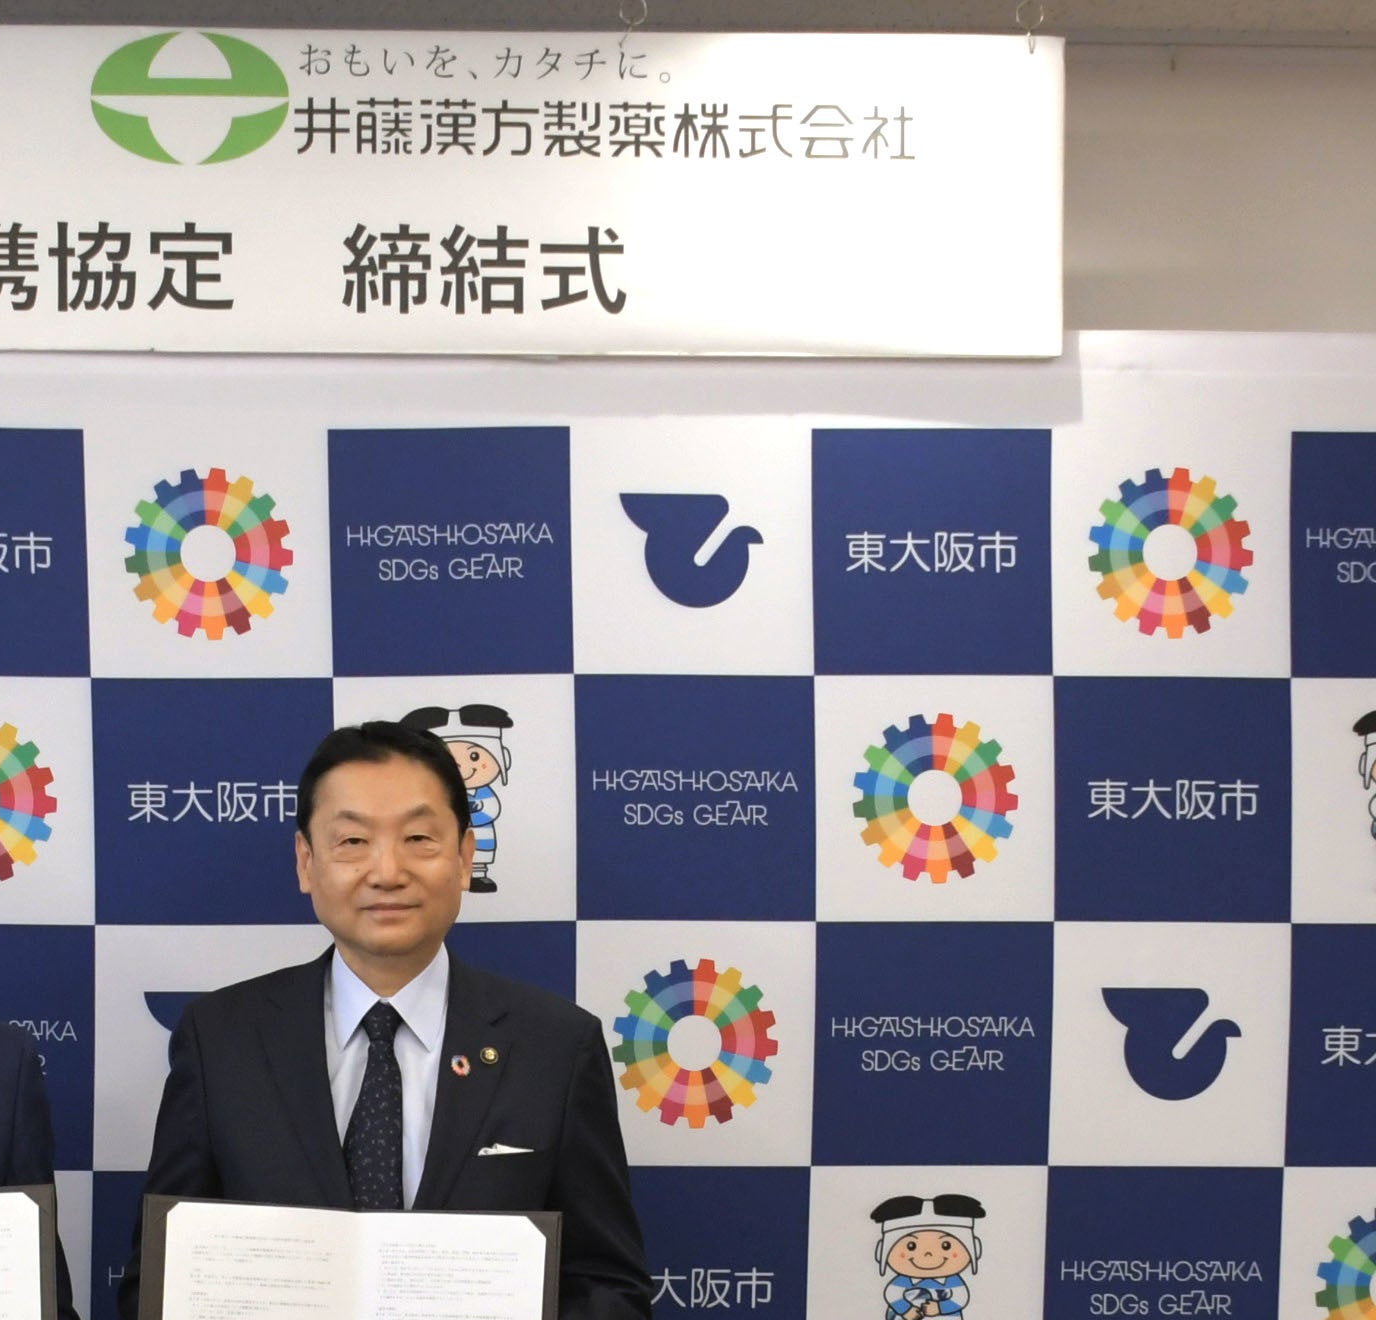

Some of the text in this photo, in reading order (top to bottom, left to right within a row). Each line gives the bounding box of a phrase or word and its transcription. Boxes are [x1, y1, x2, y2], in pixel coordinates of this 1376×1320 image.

[299, 44, 675, 83] おもいを、カタチに。
[294, 96, 914, 159] 井藤漢方製薬株式会社
[342, 223, 626, 314] 締結式
[347, 523, 553, 546] HIGASHIOSAKA
[846, 531, 1018, 573] 東大阪市
[379, 553, 524, 581] SDGs GEAR
[593, 770, 798, 792] HIGASHIOSAKA
[128, 780, 298, 823] 東大阪市
[624, 800, 768, 825] SDGs GEAR
[1088, 778, 1259, 821] 東大阪市
[832, 1016, 1035, 1037] HIGASHIOSAKA
[861, 1046, 1004, 1071] SDGs GEAR
[1061, 1260, 1262, 1281] HIGASHIOSAKA
[651, 1267, 774, 1308] 大阪市
[1090, 1290, 1232, 1315] SDGs GEAR
